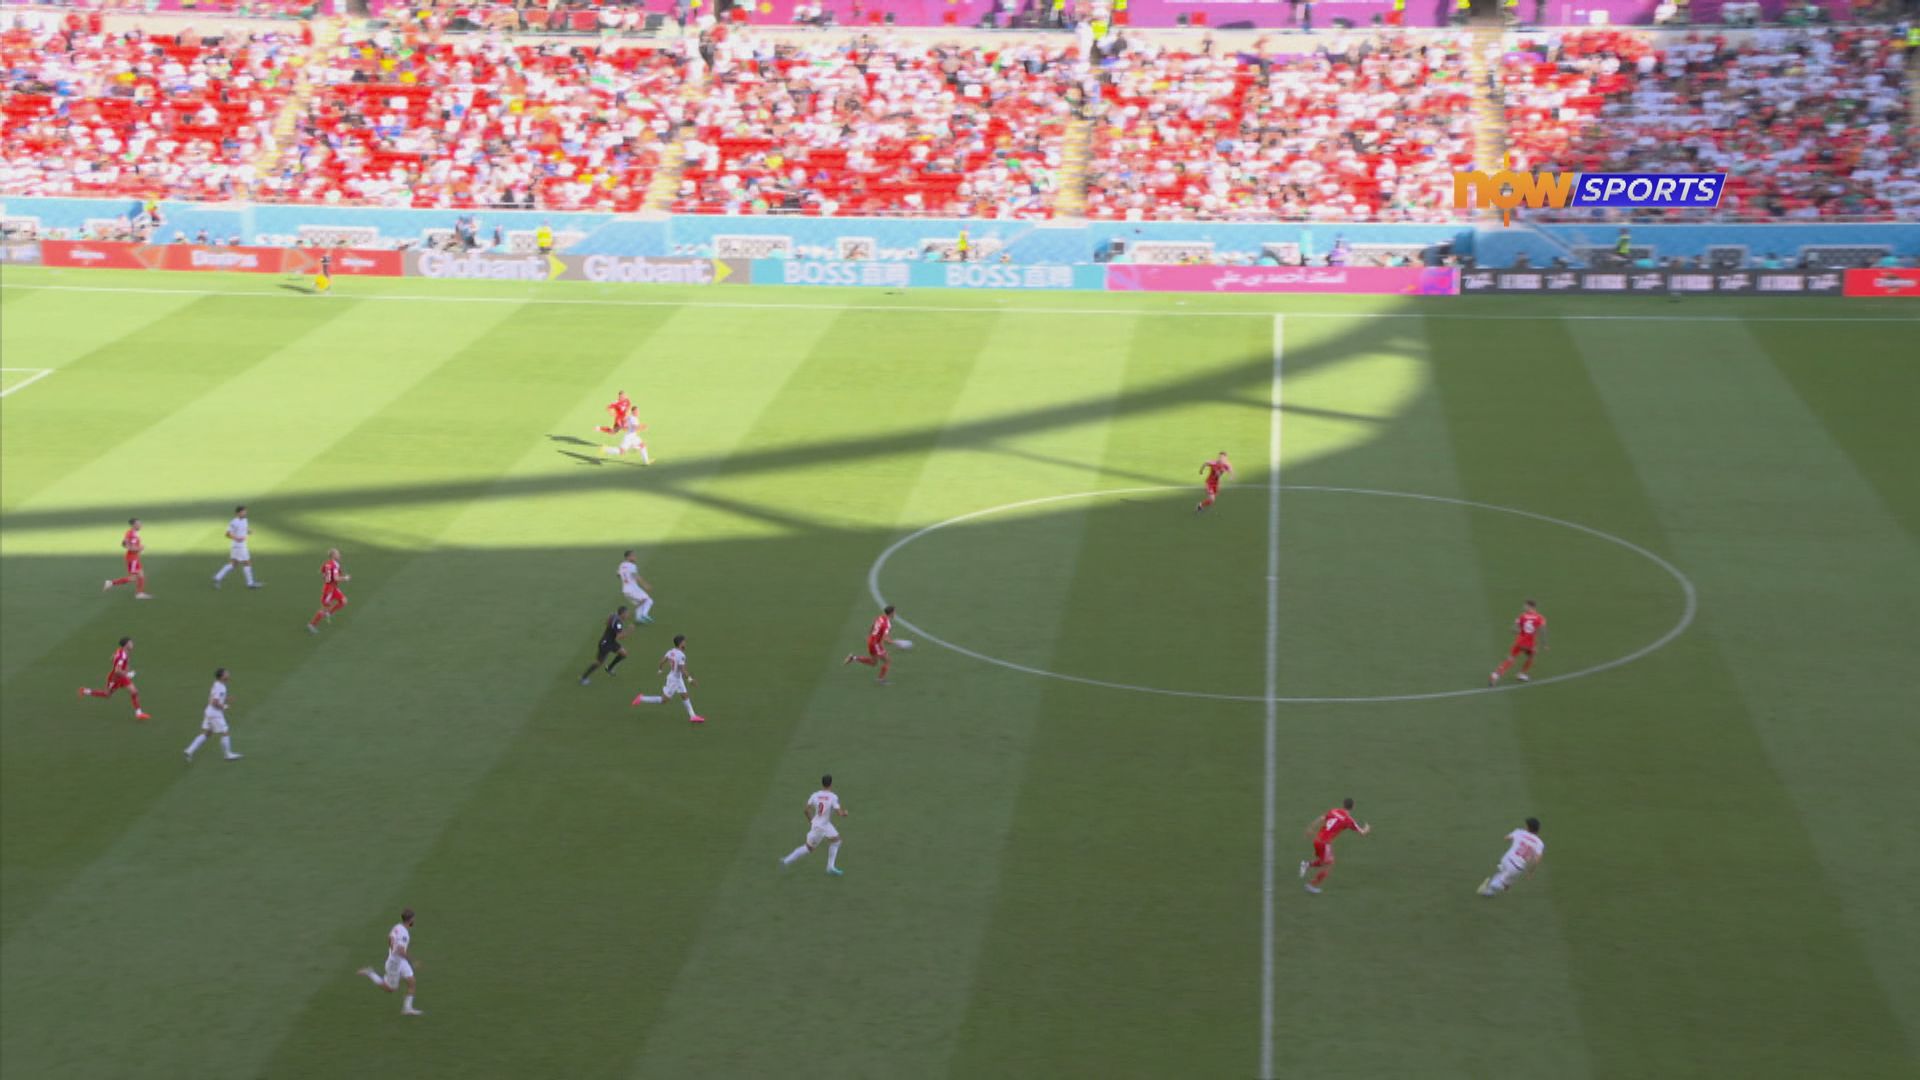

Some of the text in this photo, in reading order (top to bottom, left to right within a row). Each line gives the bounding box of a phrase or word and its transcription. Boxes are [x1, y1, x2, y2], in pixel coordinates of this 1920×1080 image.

[418, 248, 547, 279] Globant
[583, 254, 713, 284] Globant
[784, 261, 857, 283] BOSS
[945, 264, 1020, 287] BOSS
